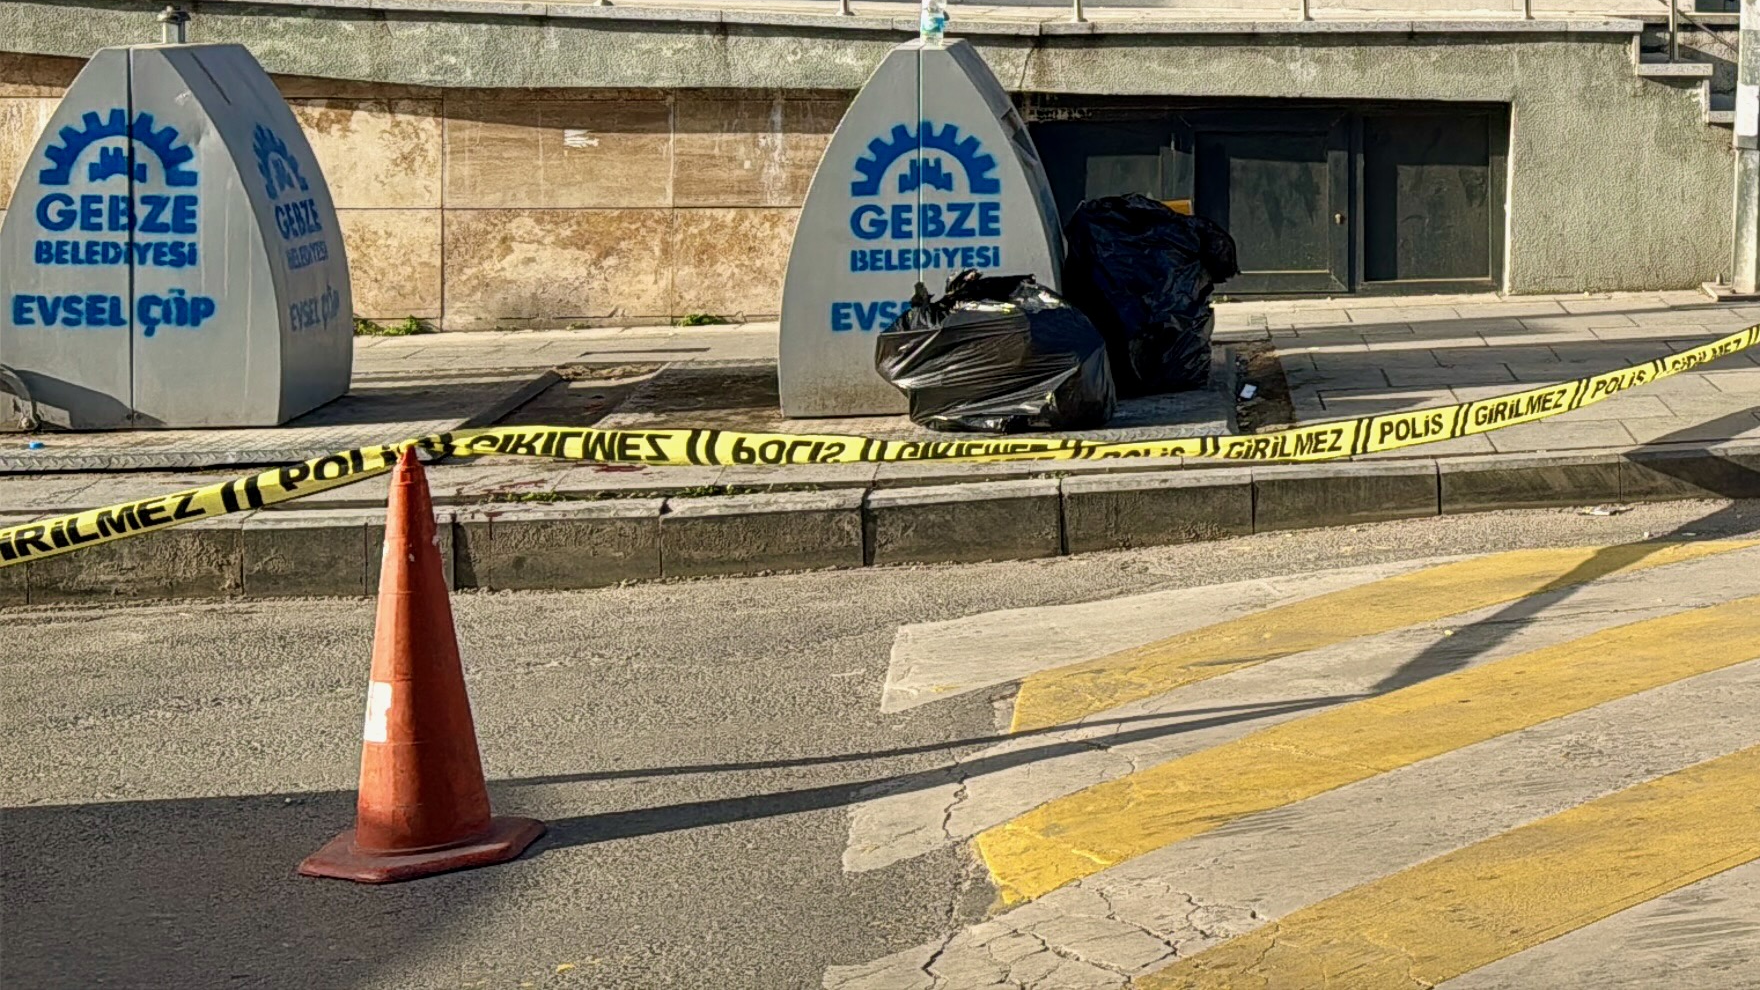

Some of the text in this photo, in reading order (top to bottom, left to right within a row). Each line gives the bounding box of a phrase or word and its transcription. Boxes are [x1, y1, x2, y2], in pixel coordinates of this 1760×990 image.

[36, 193, 198, 234] GEBZE
[275, 199, 322, 239] GEBZE
[850, 202, 1001, 240] GEBZE
[35, 240, 197, 268] BELEDİYESİ
[851, 246, 1000, 272] BELEDİYESİ
[13, 295, 127, 326] EVSEL
[831, 301, 912, 332] EVS
[1378, 413, 1444, 444] POLİS
[1474, 389, 1567, 426] GİRİLMEZ
[0, 491, 206, 560] İRİLMEZ
